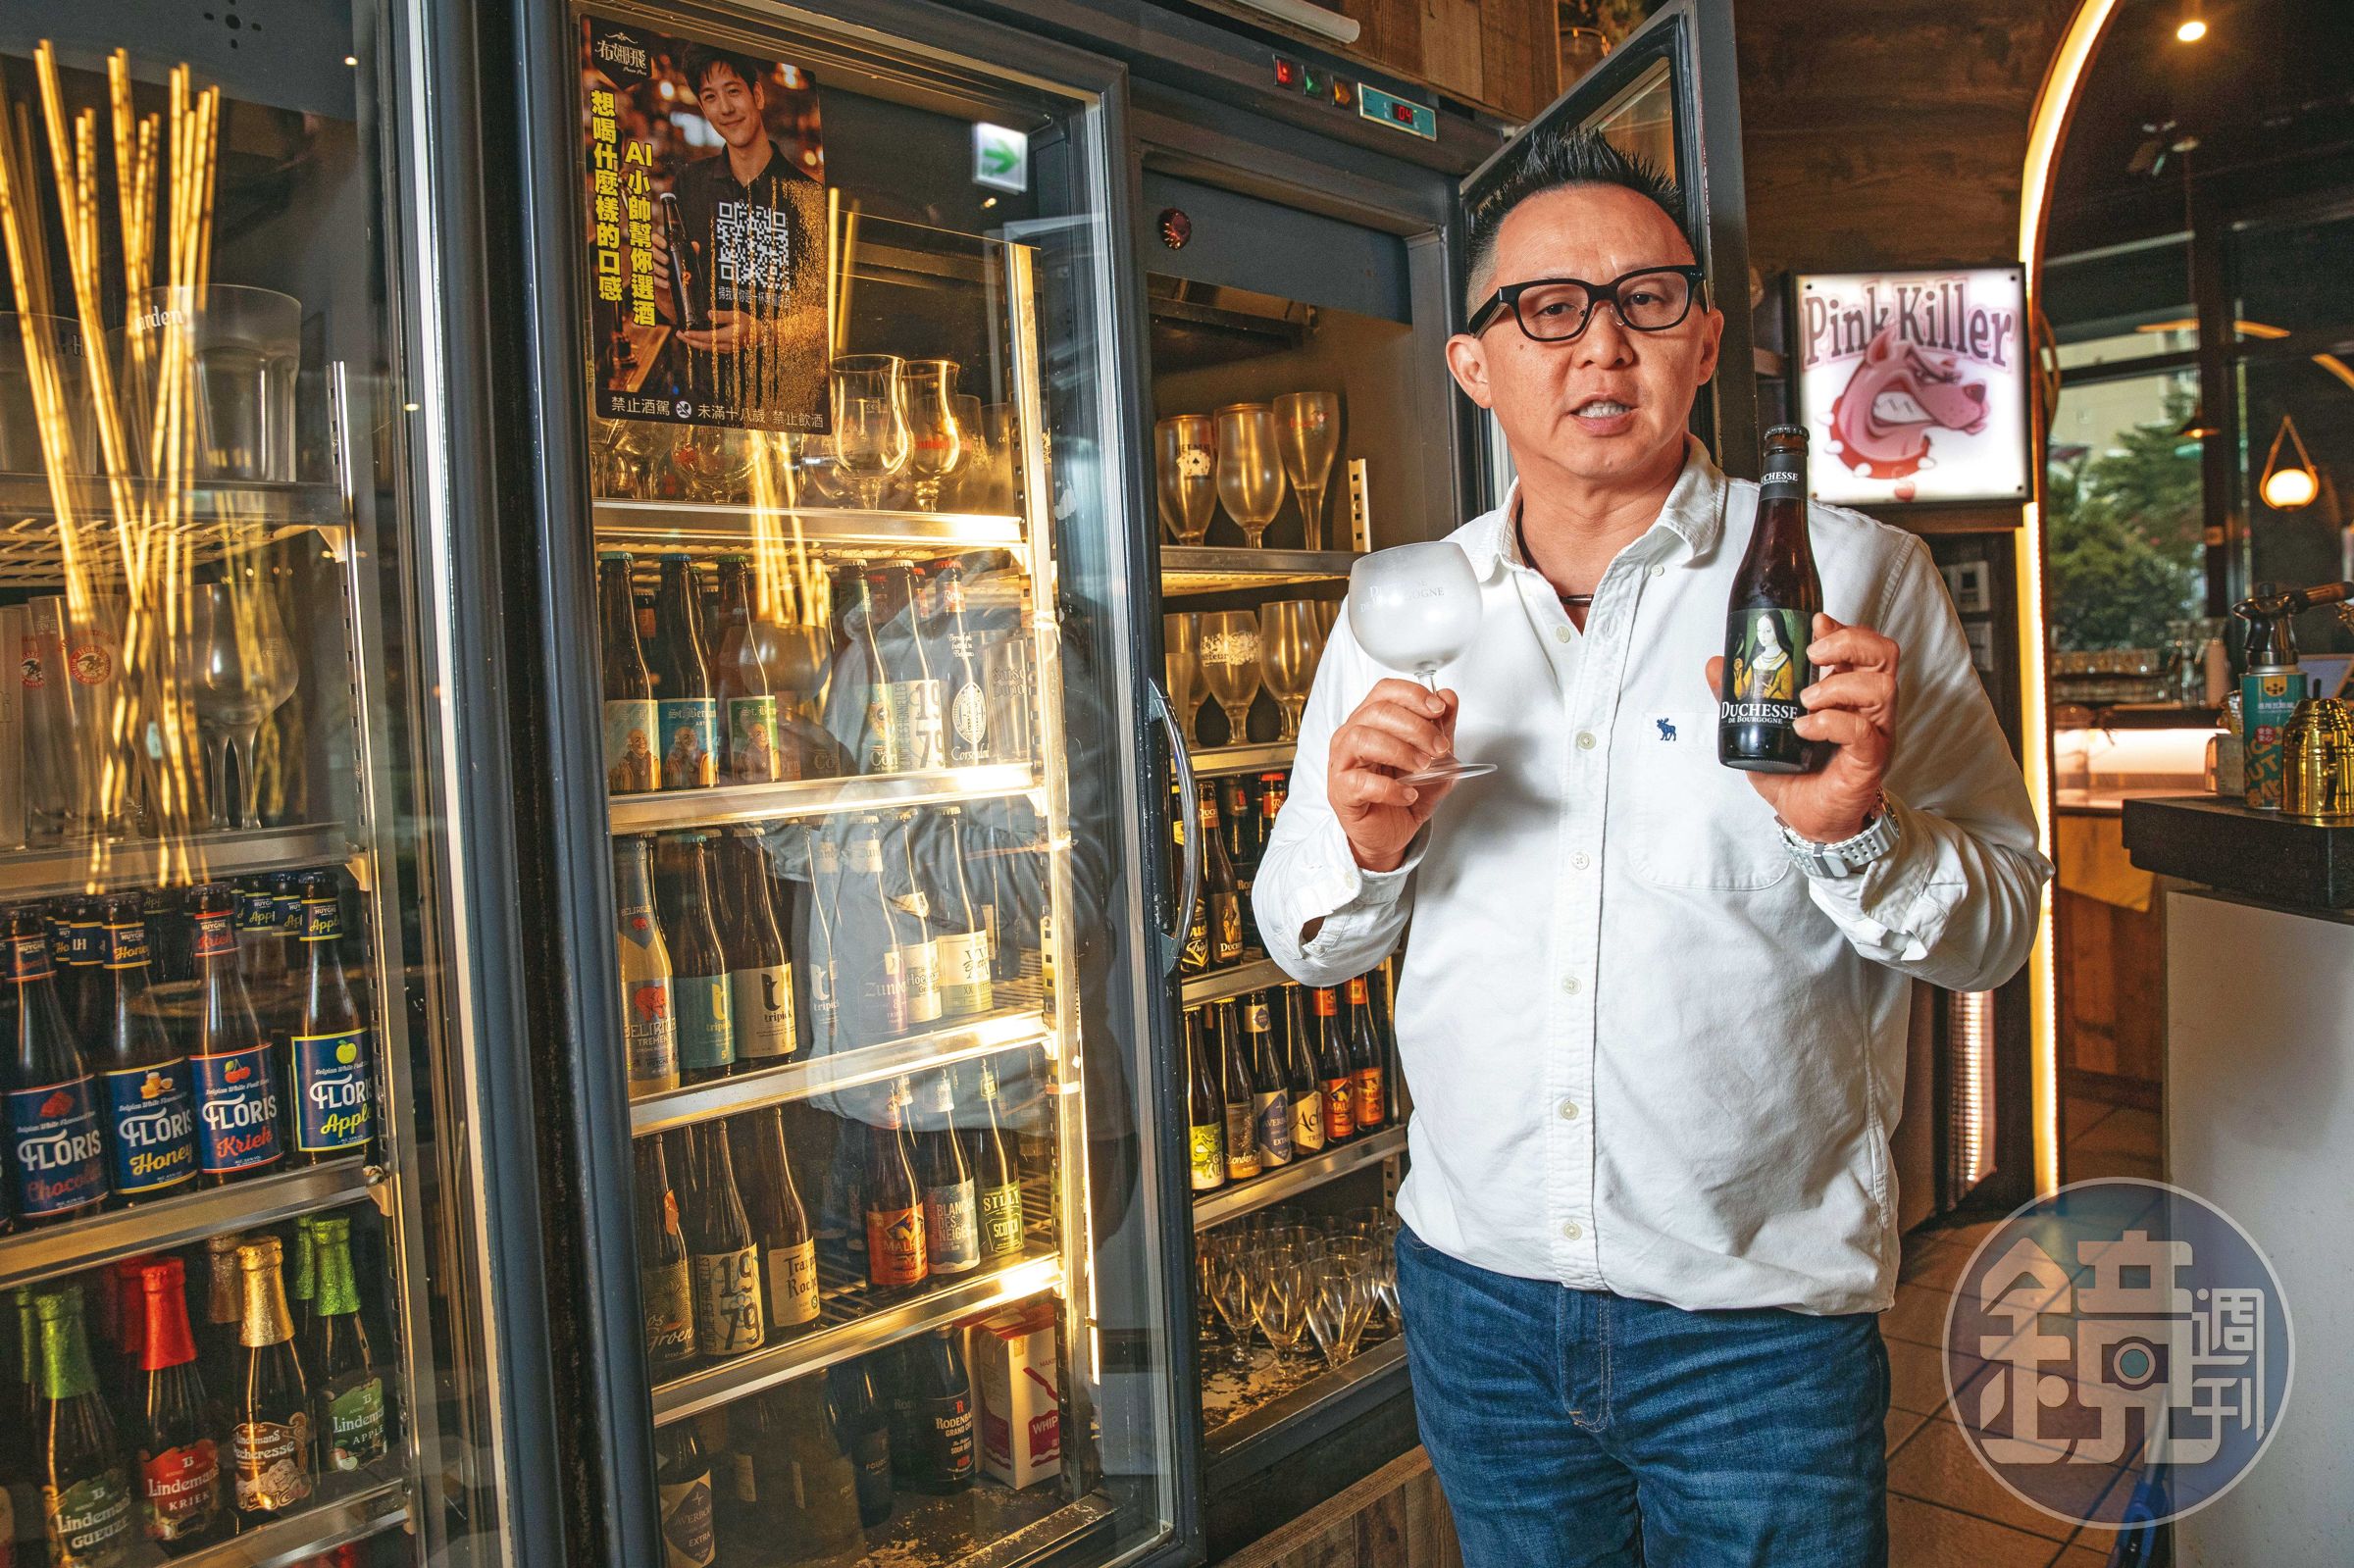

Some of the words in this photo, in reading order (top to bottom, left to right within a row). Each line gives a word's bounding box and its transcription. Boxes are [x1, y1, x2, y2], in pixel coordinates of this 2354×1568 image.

[590, 90, 622, 302] 想喝什麼樣的口感
[624, 141, 656, 327] AI小帥幫你選酒
[1805, 285, 1890, 366] Pink
[1897, 282, 2012, 367] Killer
[611, 396, 670, 416] 禁止酒駕
[697, 403, 766, 424] 未滿十八歲
[772, 412, 823, 429] 禁止飲酒
[1720, 701, 1798, 720] DUCHESSE
[1736, 716, 1783, 725] BOURGOGNE
[119, 1106, 193, 1147] FLORIS
[202, 1092, 278, 1131] FLORIS
[17, 1129, 102, 1172] FLORIS
[937, 1196, 974, 1217] BLANCHE
[983, 1189, 1020, 1212] SILLY
[939, 1216, 955, 1229] DES
[718, 1250, 754, 1297] 19
[720, 1301, 760, 1351] 79
[689, 1531, 711, 1547] EXTRA
